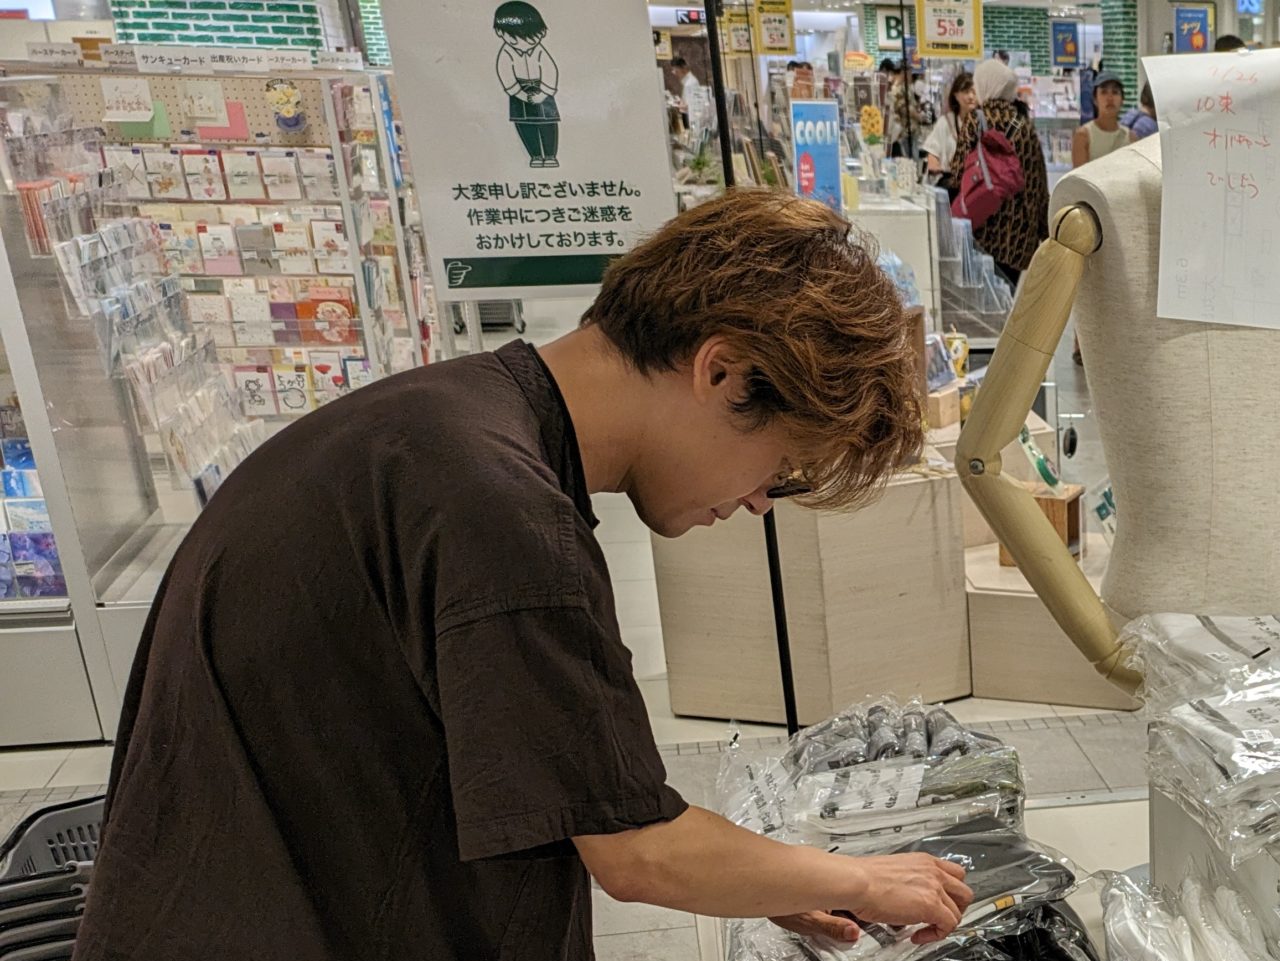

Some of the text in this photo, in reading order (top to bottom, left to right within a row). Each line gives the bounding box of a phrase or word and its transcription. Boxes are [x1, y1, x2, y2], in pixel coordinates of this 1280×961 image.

[452, 181, 641, 201] 大変申し訳ございません。
[467, 205, 633, 226] 作業中につきご迷惑を
[476, 231, 626, 250] おかけしております。
